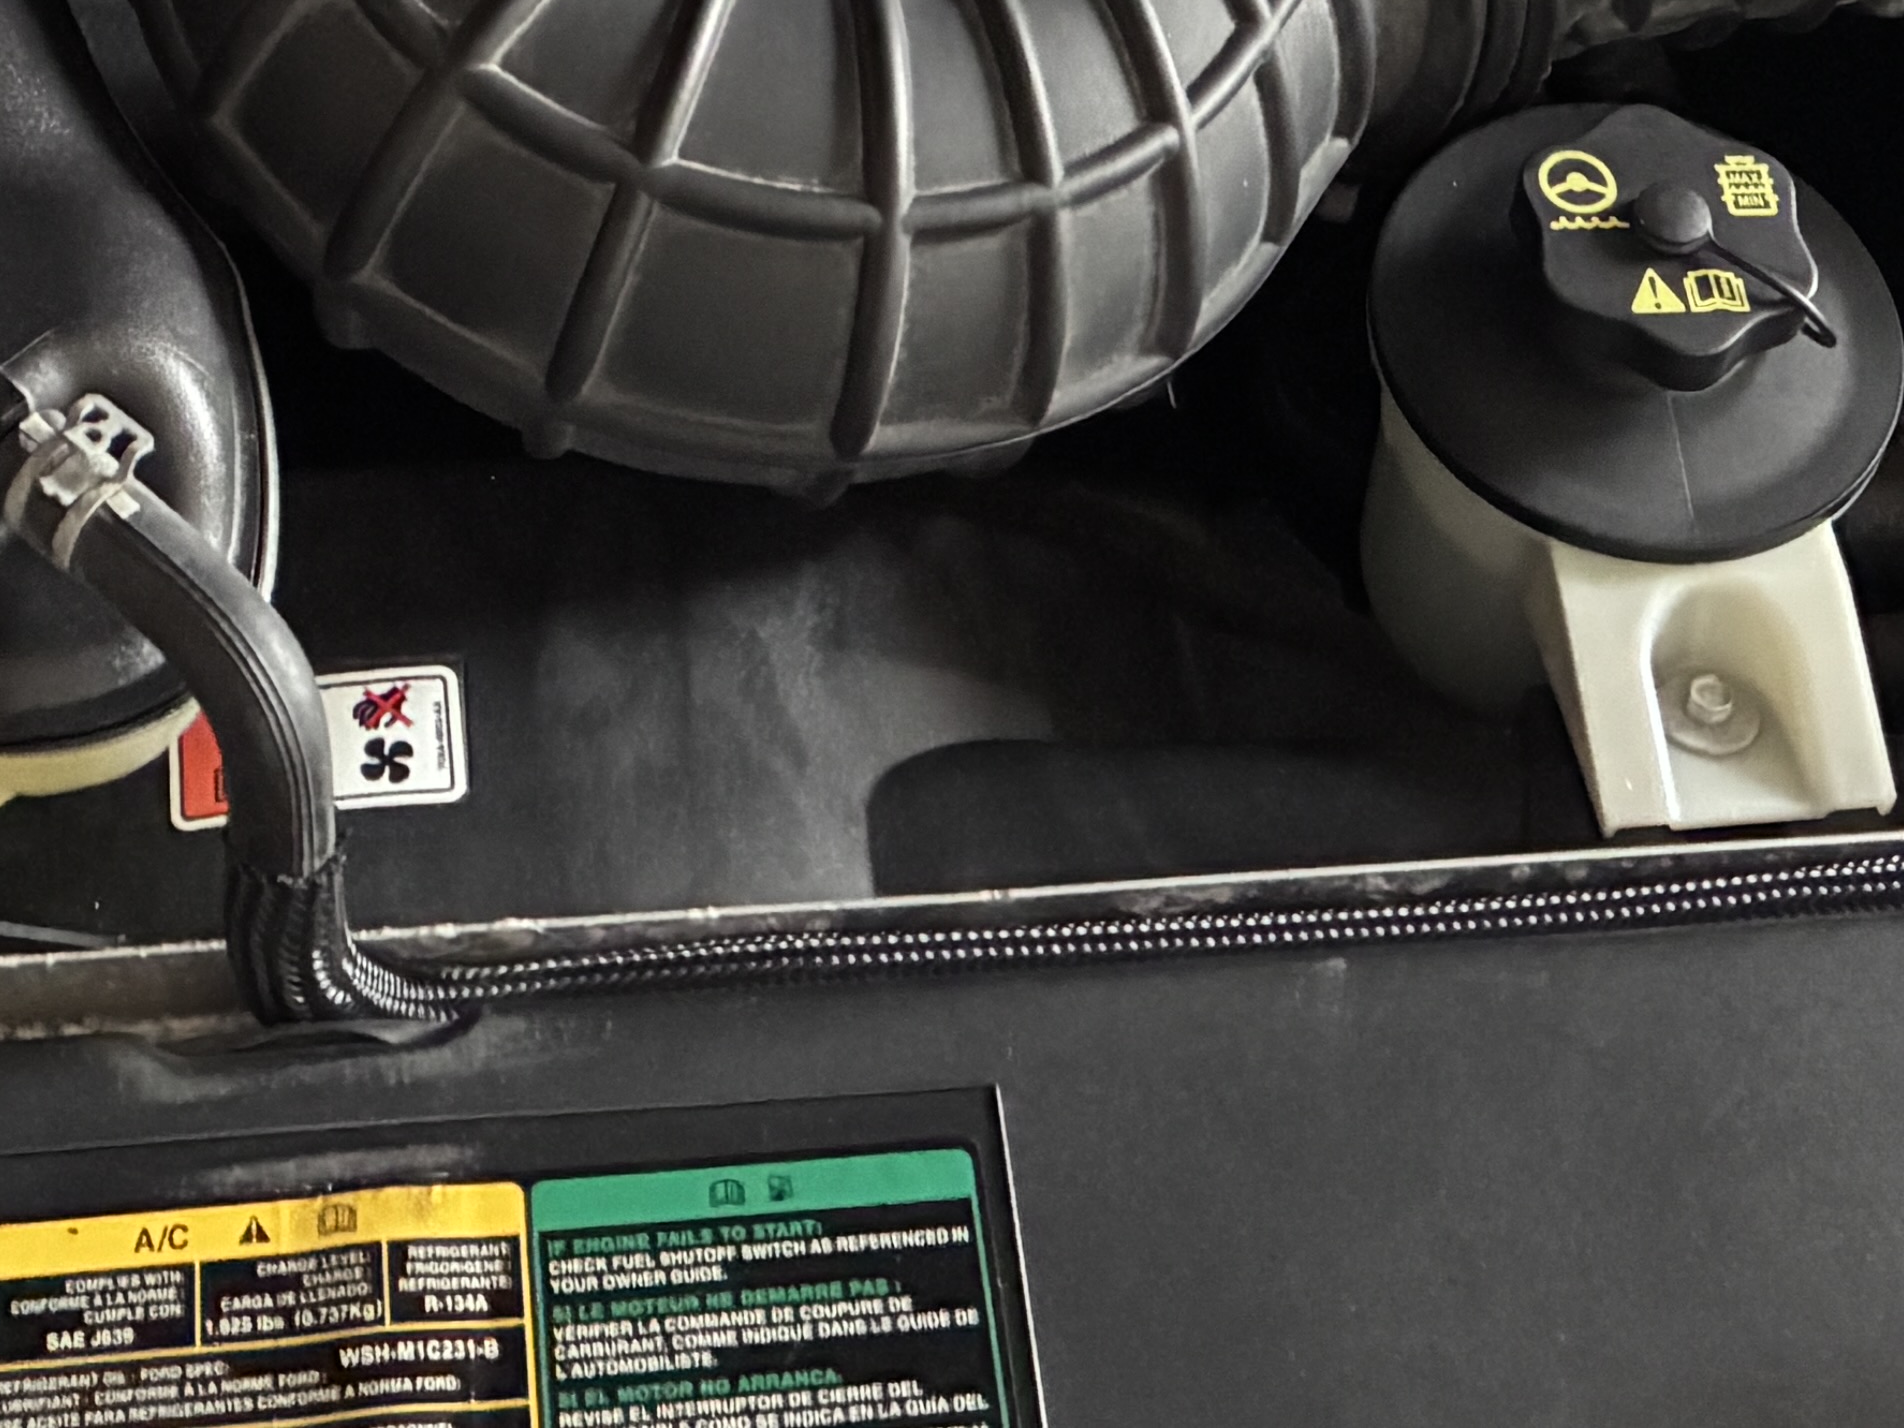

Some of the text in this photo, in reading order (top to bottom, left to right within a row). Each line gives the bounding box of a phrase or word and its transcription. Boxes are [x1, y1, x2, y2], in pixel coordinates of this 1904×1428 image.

[1727, 170, 1763, 184] MAX
[1736, 193, 1765, 207] MIN
[133, 1222, 190, 1255] A/C
[719, 1223, 748, 1242] TO
[548, 1224, 970, 1277] CHECK FUEL SHUTOFF SWITCH AS REFERENCED IN
[64, 1273, 142, 1295] COMPLIES
[549, 1273, 600, 1295] YOUR
[601, 1268, 668, 1291] OWNER
[219, 1292, 274, 1313] CARGA
[276, 1290, 297, 1307] DE
[423, 1292, 489, 1313] R-134A
[636, 1316, 662, 1336] LA
[663, 1307, 767, 1334] COMMANDE
[770, 1304, 795, 1324] DE
[799, 1297, 885, 1322] COUPURE
[888, 1294, 914, 1314] DE
[45, 1329, 86, 1353] SAE
[671, 1328, 739, 1352] COMME
[817, 1317, 867, 1340] DANS
[869, 1314, 893, 1335] LE
[896, 1308, 954, 1333] GUIDE
[954, 1305, 981, 1327] DE
[338, 1336, 501, 1369] WSH-M1C231-B
[83, 1408, 127, 1427] PARA
[357, 1376, 414, 1398] NORMA
[557, 1405, 625, 1428] REVISE
[628, 1403, 653, 1424] EL
[655, 1391, 784, 1421] INTERRUPTOR
[787, 1388, 813, 1408] DE
[816, 1381, 884, 1404] CIERRE
[887, 1378, 924, 1399] DEL
[616, 1379, 695, 1404] MOTOR
[699, 1376, 732, 1396] NO
[782, 1402, 848, 1428] INDICA
[848, 1402, 875, 1423] EN
[876, 1399, 903, 1420] LA
[952, 1391, 991, 1414] DEL
